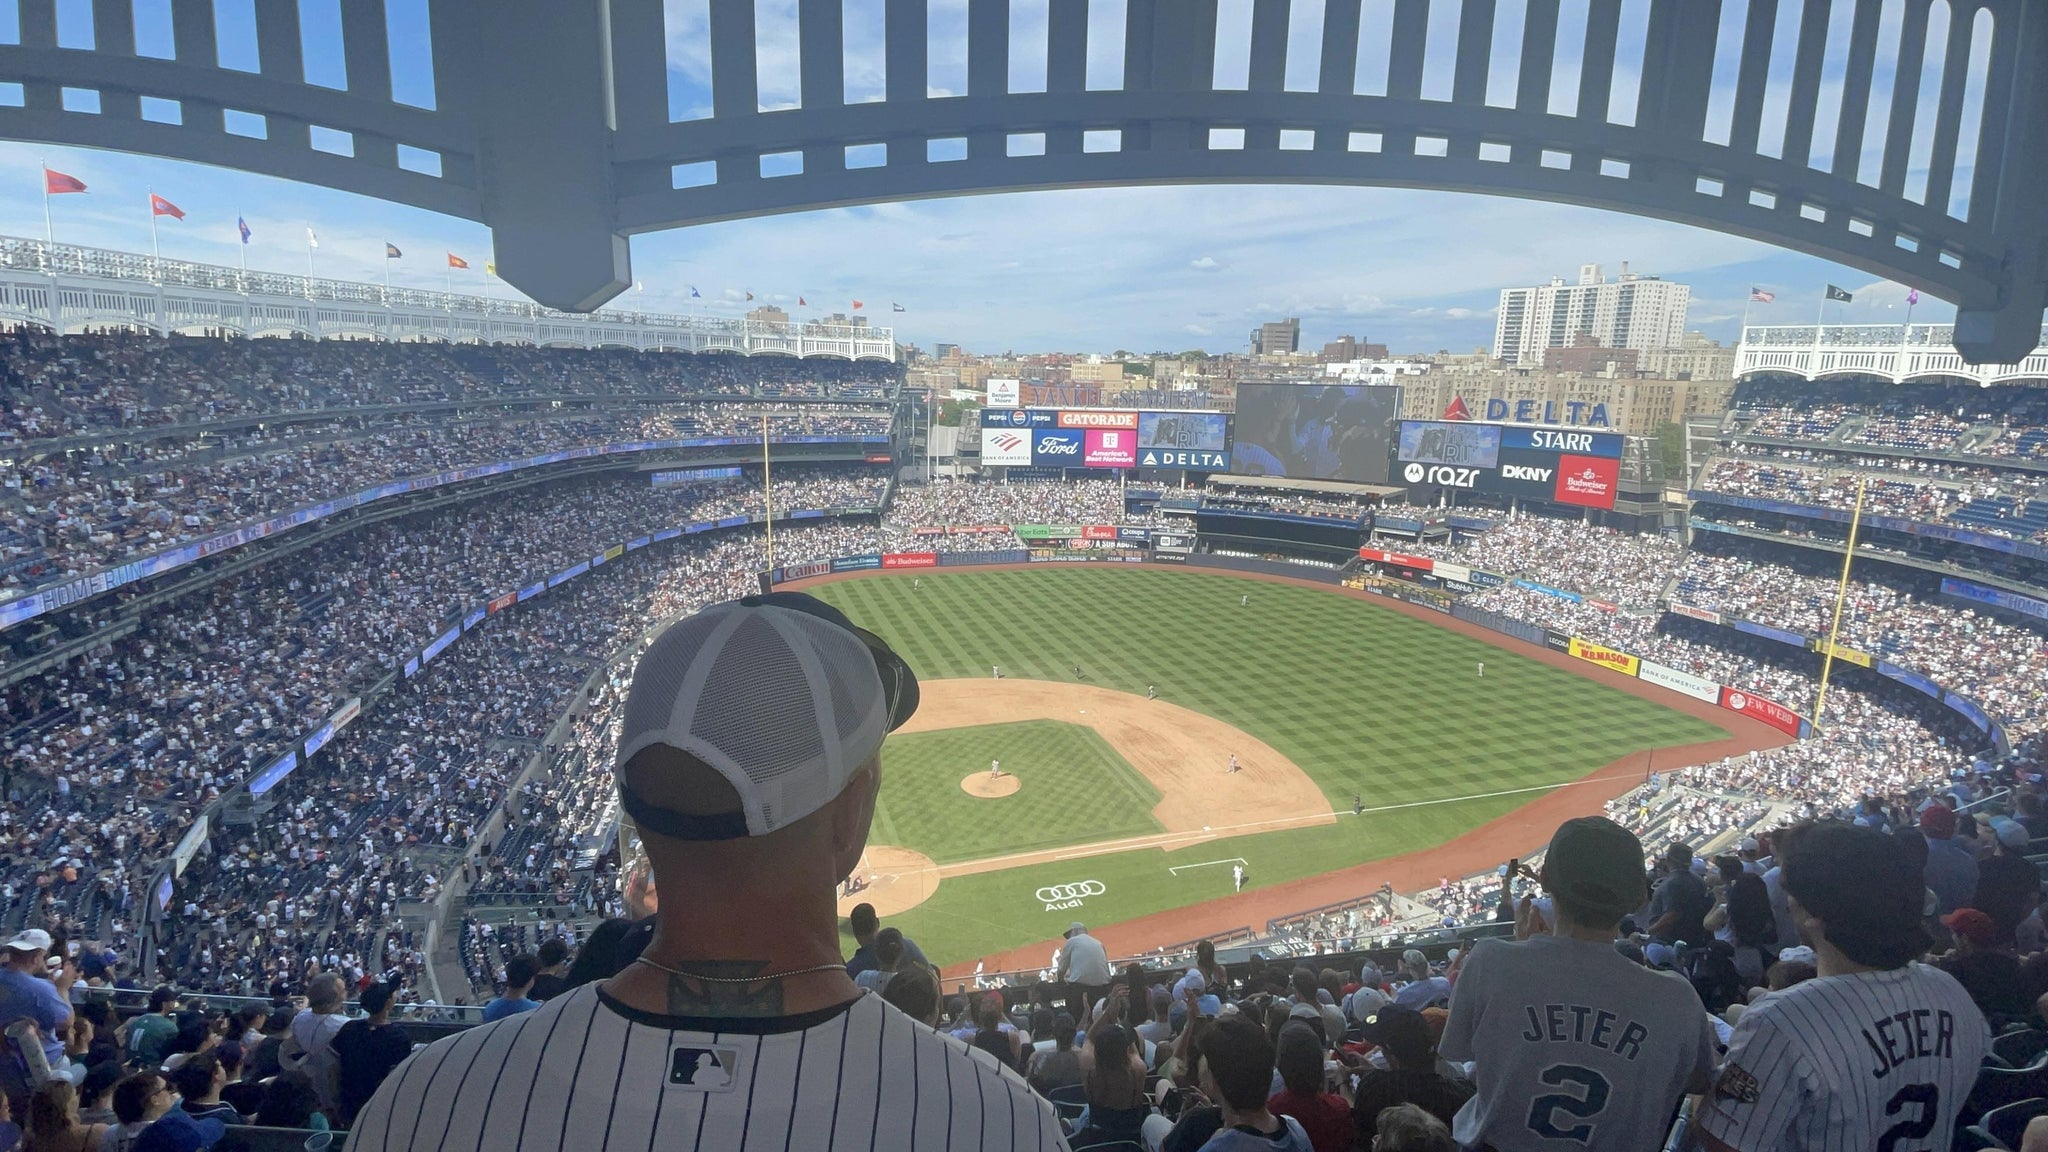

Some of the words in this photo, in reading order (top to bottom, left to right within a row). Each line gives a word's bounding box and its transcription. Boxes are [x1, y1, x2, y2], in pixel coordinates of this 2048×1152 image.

[1062, 412, 1133, 426] GATORADE
[1487, 398, 1611, 427] DELTA
[1037, 436, 1079, 455] Ford
[1531, 430, 1593, 452] STARR
[1091, 450, 1128, 458] America's
[1103, 456, 1134, 464] Network
[1163, 453, 1224, 466] DELTA
[665, 469, 701, 481] HOME
[701, 467, 728, 479] RUN
[1427, 467, 1480, 488] razr
[1502, 464, 1553, 483] DKNY
[1567, 477, 1608, 490] Budweiser
[209, 533, 240, 550] DELTA
[785, 562, 829, 579] Canon
[898, 557, 934, 565] Budweiser
[41, 574, 103, 611] HOME
[104, 560, 143, 590] RUN
[1446, 580, 1473, 592] StubHub
[2008, 597, 2046, 616] HOME
[1596, 651, 1630, 667] MASON
[1642, 667, 1659, 678] BANK
[1669, 676, 1701, 691] AMERICA
[1767, 703, 1793, 725] WEBB
[1045, 898, 1084, 912] Audi
[1522, 1003, 1650, 1062] JETER
[1861, 1008, 1955, 1080] JETER
[1526, 1063, 1613, 1146] 2
[1876, 1082, 1940, 1152] 2
